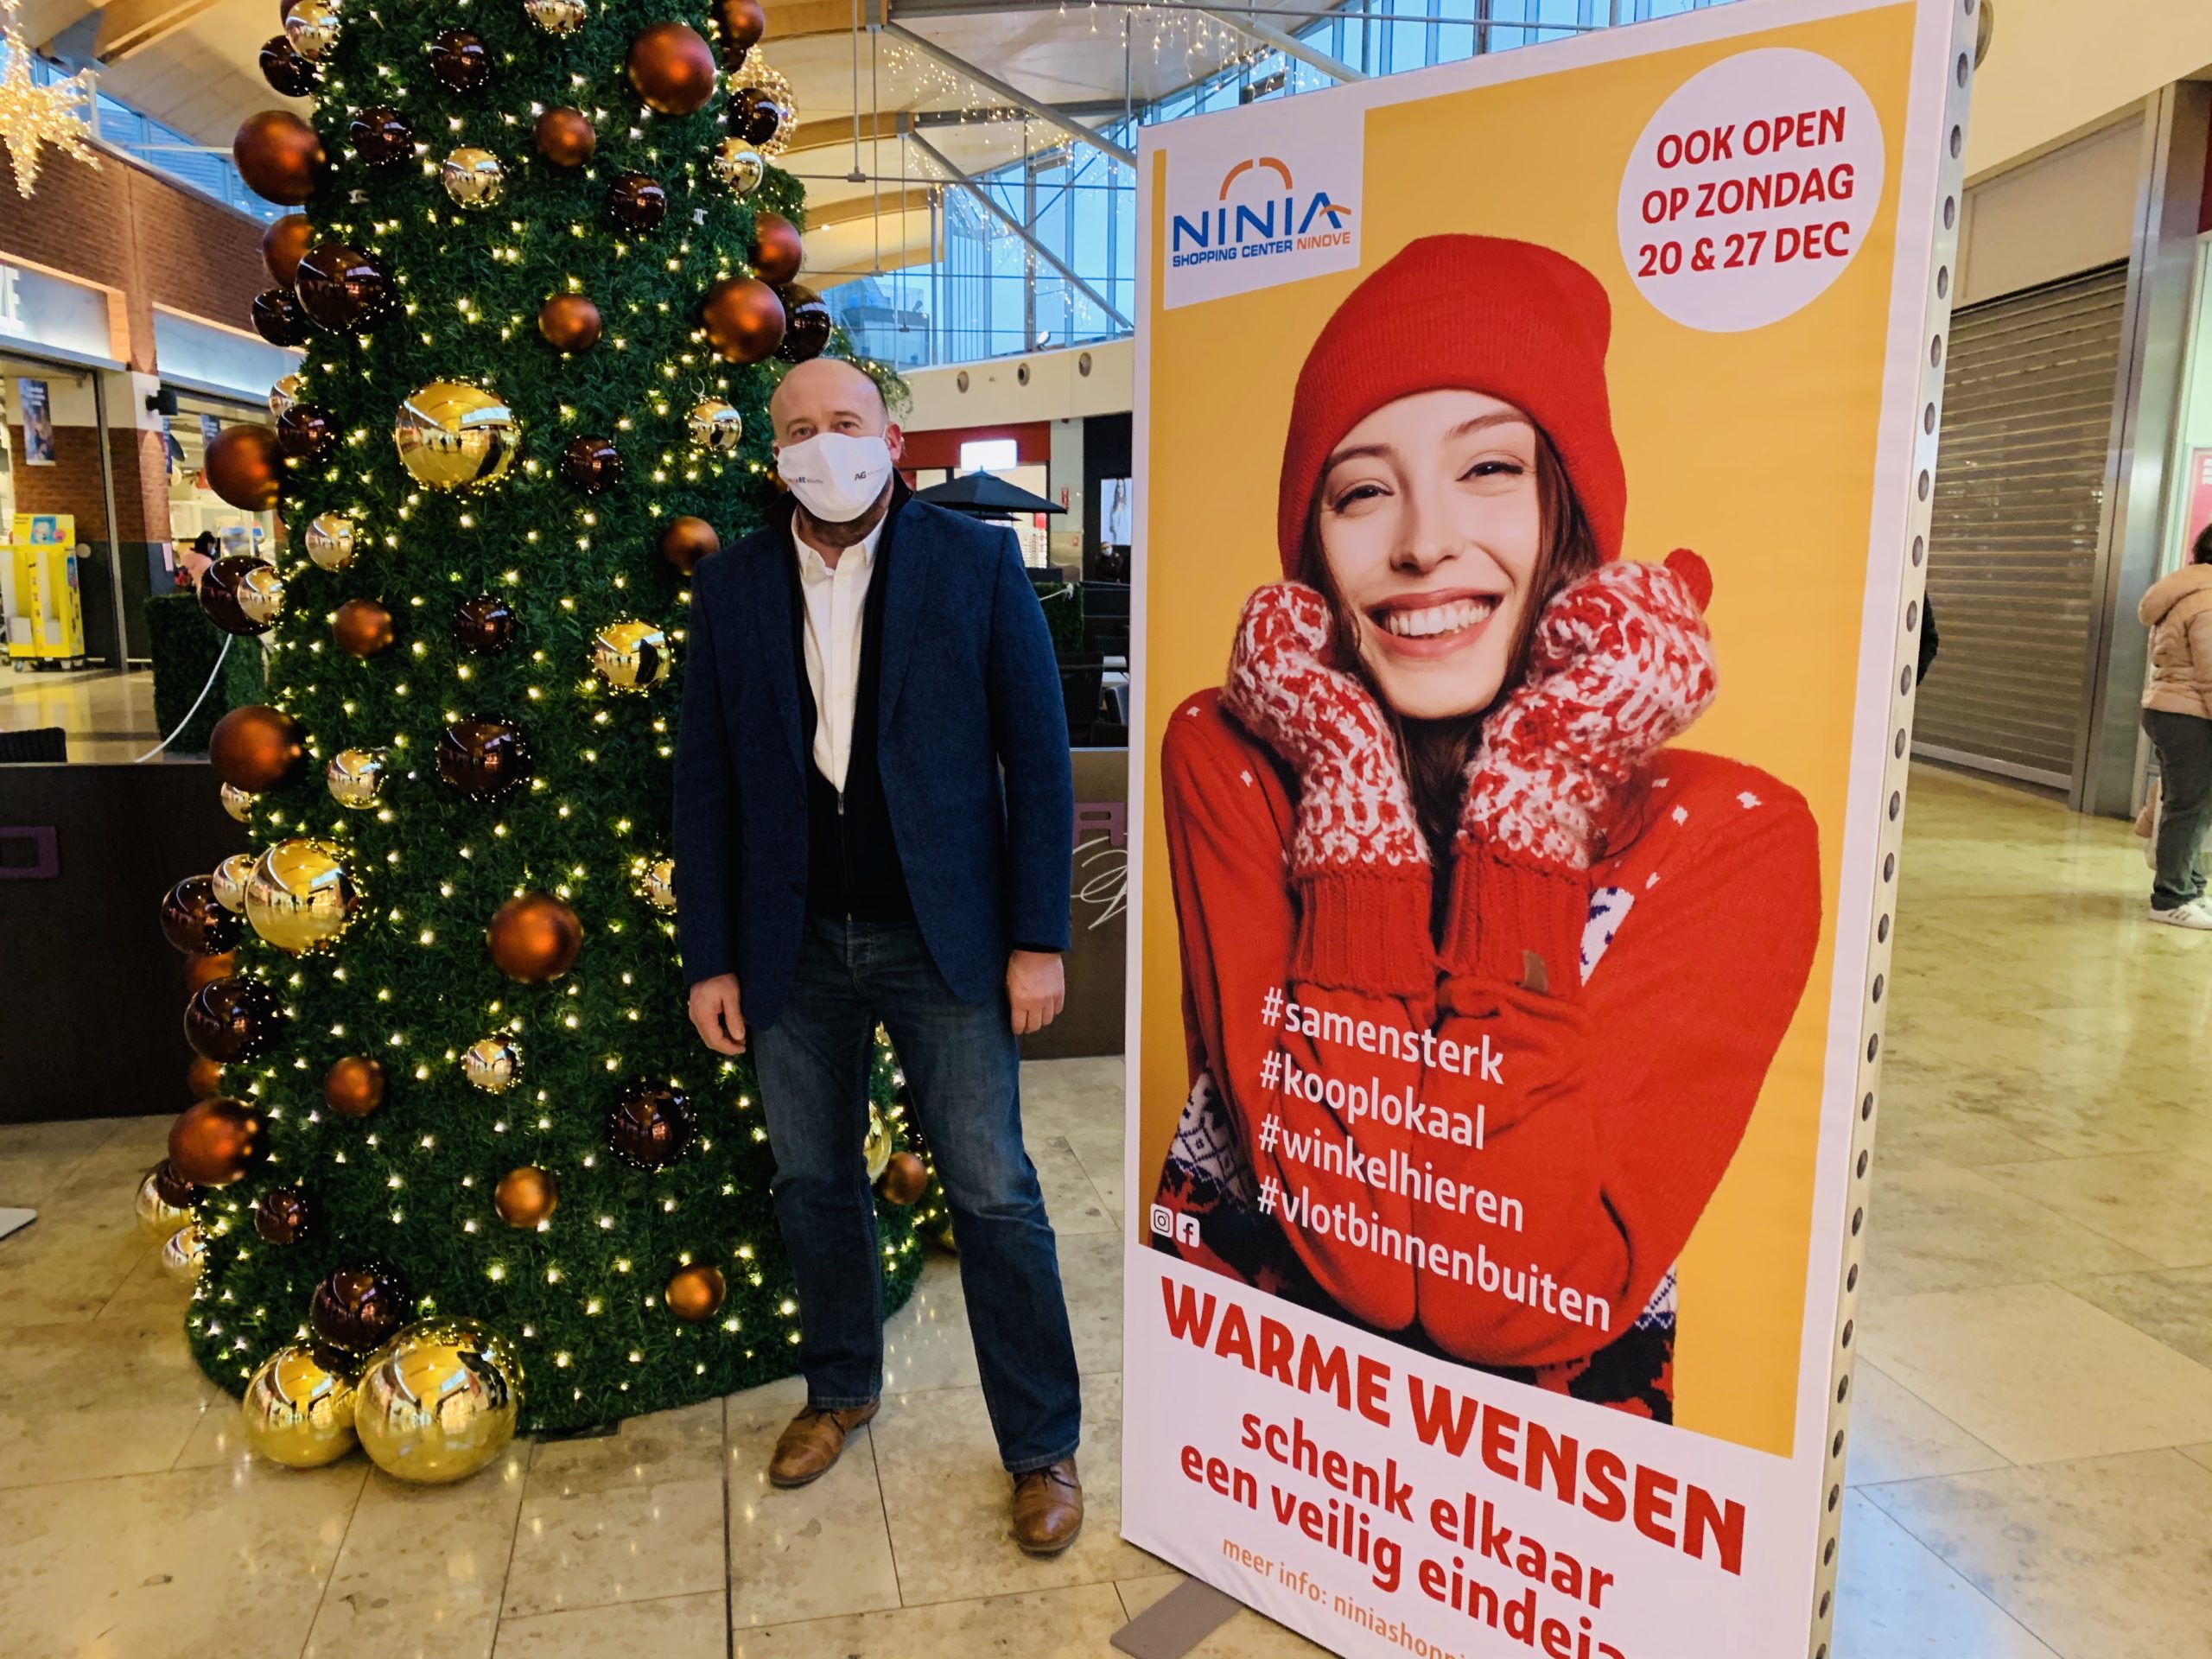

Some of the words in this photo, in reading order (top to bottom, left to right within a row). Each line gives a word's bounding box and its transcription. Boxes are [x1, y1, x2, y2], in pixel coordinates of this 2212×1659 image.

[1656, 124, 1736, 169] OOK
[1742, 105, 1847, 156] OPEN
[1173, 191, 1352, 252] NINIA
[1642, 187, 1690, 225] OP
[1695, 162, 1854, 219] ZONDAG
[1173, 247, 1237, 268] SHOPPING
[1242, 239, 1293, 258] CENTER
[1297, 231, 1351, 250] NINOVE
[1637, 241, 1683, 277] 20
[1690, 237, 1715, 272] &
[1723, 230, 1768, 269] 27
[1774, 220, 1851, 264] DEC
[1261, 986, 1504, 1085] #samensterk
[1259, 1050, 1485, 1150] #kooplokaal
[1258, 1113, 1523, 1232] #winkelhieren
[1257, 1175, 1611, 1332] #vlotbinnenbuiten
[1161, 1276, 1391, 1428] WARME
[1408, 1374, 1746, 1576] WENSEN
[1180, 1445, 1258, 1510] een
[1271, 1484, 1402, 1593] veilig
[1241, 1409, 1414, 1522] schenk
[1430, 1492, 1614, 1610] elkaar
[1222, 1538, 1274, 1577] meer
[1279, 1562, 1327, 1605] info:
